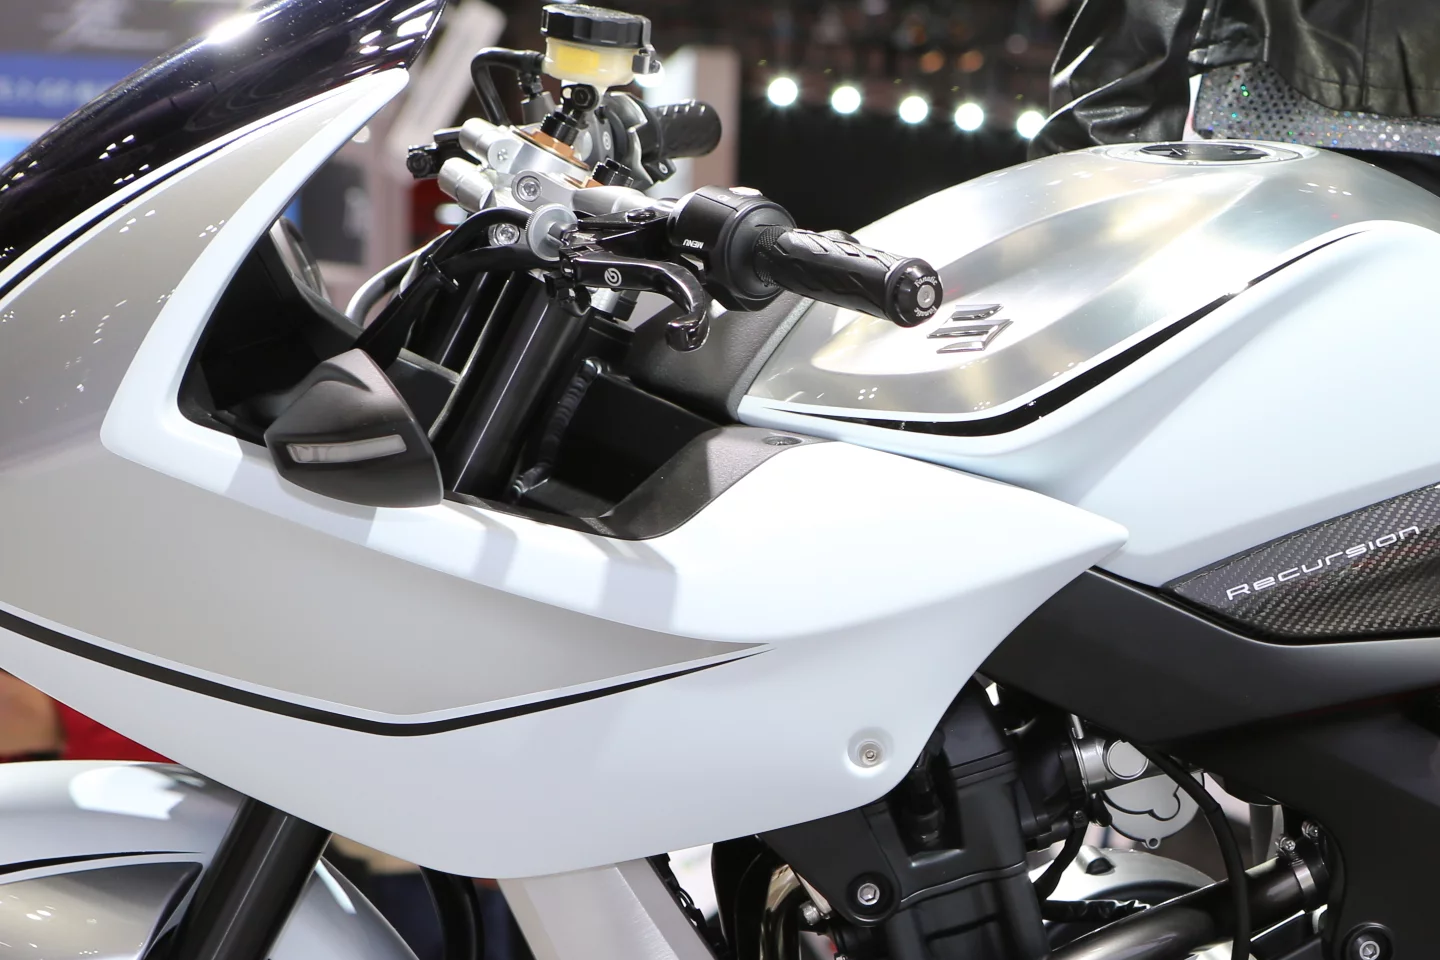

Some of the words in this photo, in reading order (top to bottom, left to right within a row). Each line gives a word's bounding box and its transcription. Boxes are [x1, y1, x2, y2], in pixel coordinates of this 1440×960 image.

[682, 238, 704, 250] MENU
[914, 276, 938, 287] Fanatic
[1226, 524, 1421, 601] Recursion
